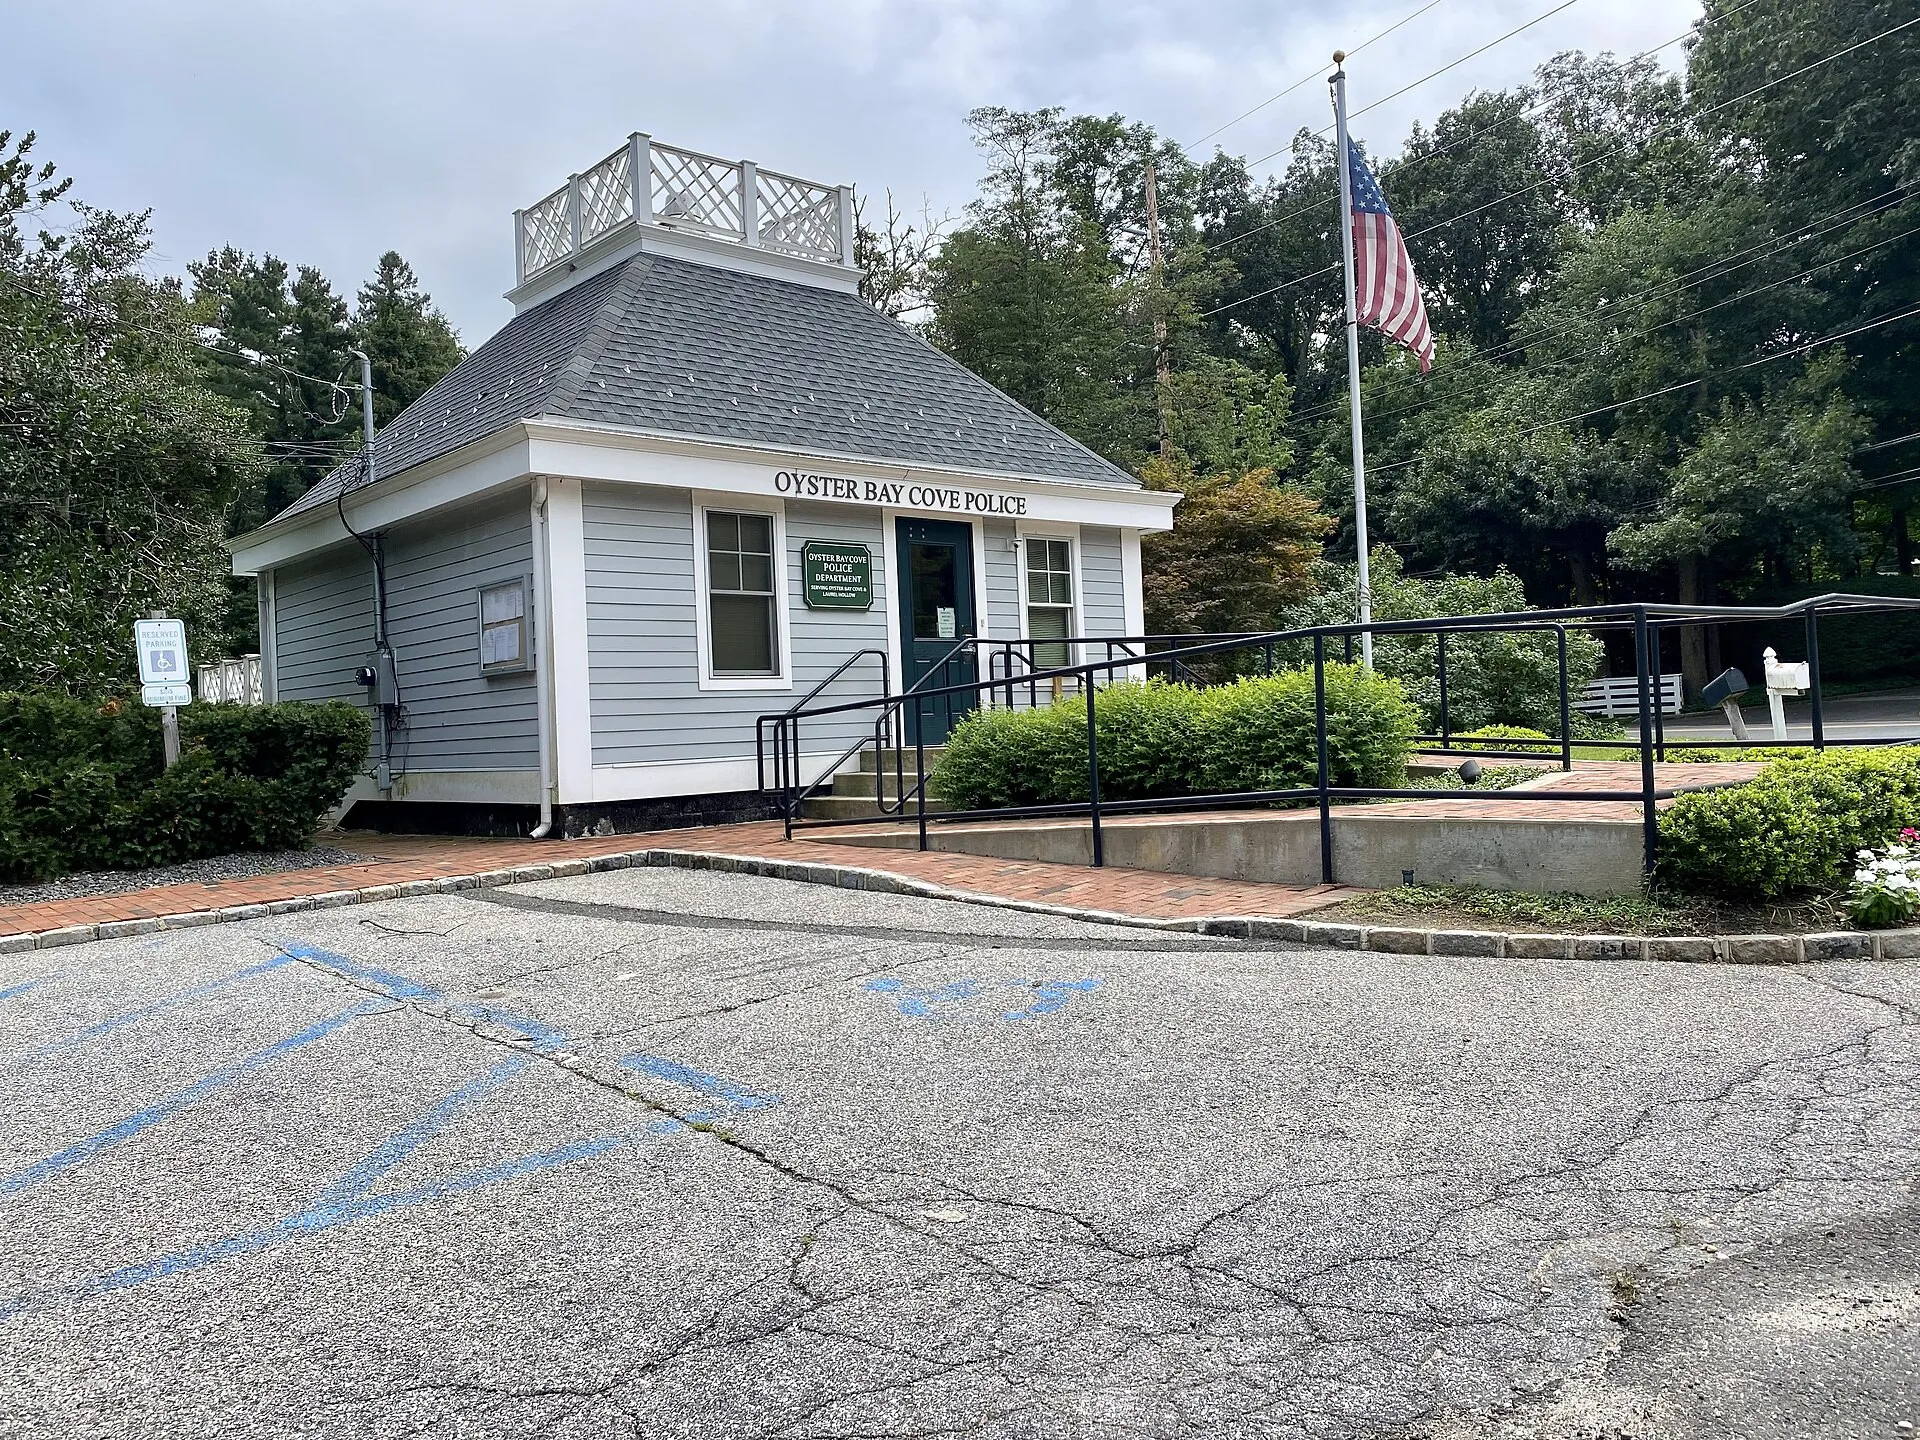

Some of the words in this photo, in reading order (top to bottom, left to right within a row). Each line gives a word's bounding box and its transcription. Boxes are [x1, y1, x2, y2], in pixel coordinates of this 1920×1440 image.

[775, 471, 858, 499] OYSTER
[864, 481, 904, 503] BAY
[909, 487, 961, 509] COVE
[964, 492, 1027, 515] POLICE
[808, 553, 835, 562] OYSTER
[823, 563, 853, 573] POLICE
[815, 574, 862, 583] DEPARTMENT
[141, 630, 179, 639] RESERVED
[145, 640, 177, 648] PARKING
